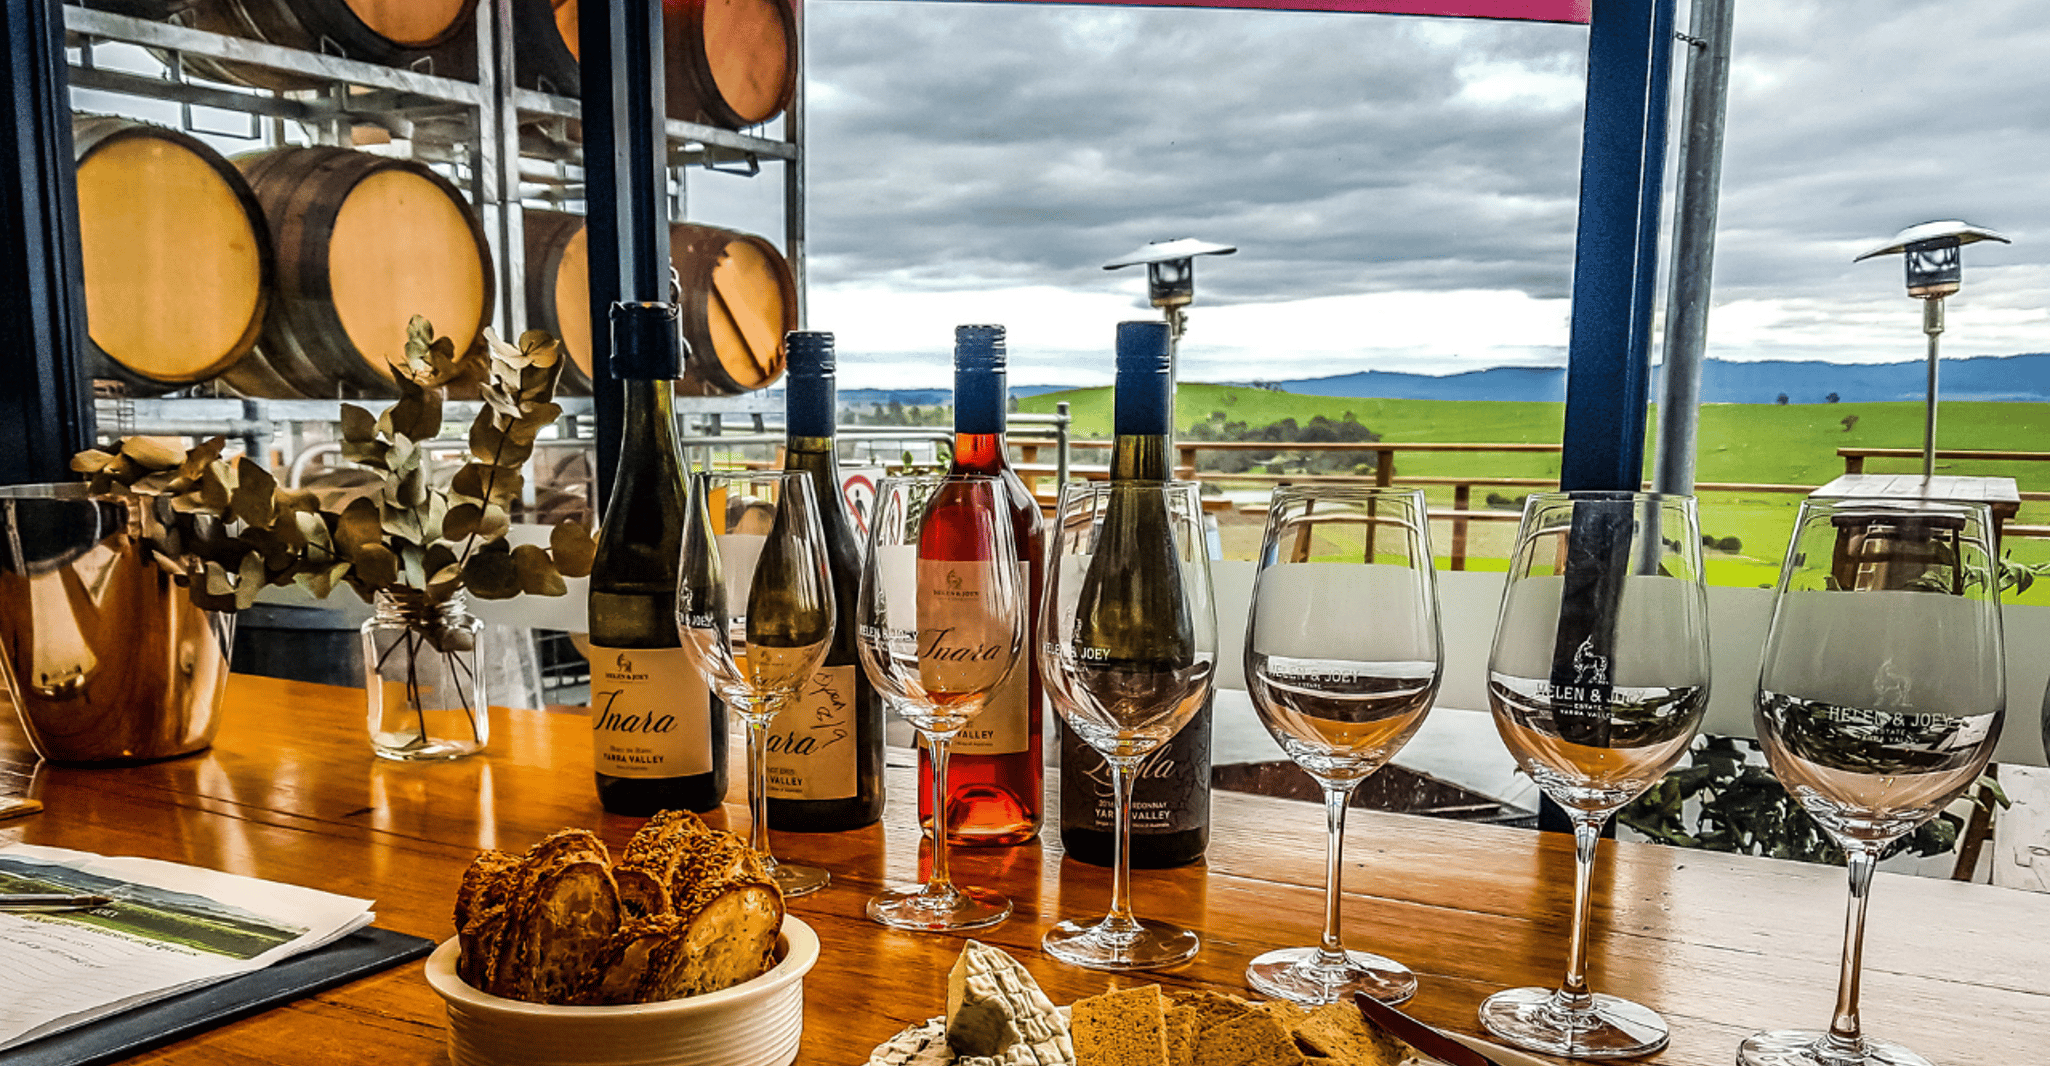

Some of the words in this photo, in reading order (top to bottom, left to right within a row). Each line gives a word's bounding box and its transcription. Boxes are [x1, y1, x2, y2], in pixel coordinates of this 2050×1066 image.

[919, 627, 1001, 662] Inara
[1081, 648, 1111, 661] JOEY
[1324, 670, 1359, 684] JOEY
[1536, 683, 1585, 702] HELEN
[1589, 689, 1602, 703] &
[593, 688, 678, 733] Inara
[1828, 706, 1885, 726] HELEN
[1892, 711, 1905, 727] &
[1910, 713, 1949, 728] JOEY
[956, 730, 994, 740] VALLEY
[629, 755, 664, 764] VALLEY
[1076, 743, 1176, 798] Lla
[770, 776, 803, 787] VALLEY
[1131, 810, 1171, 820] VALLEY
